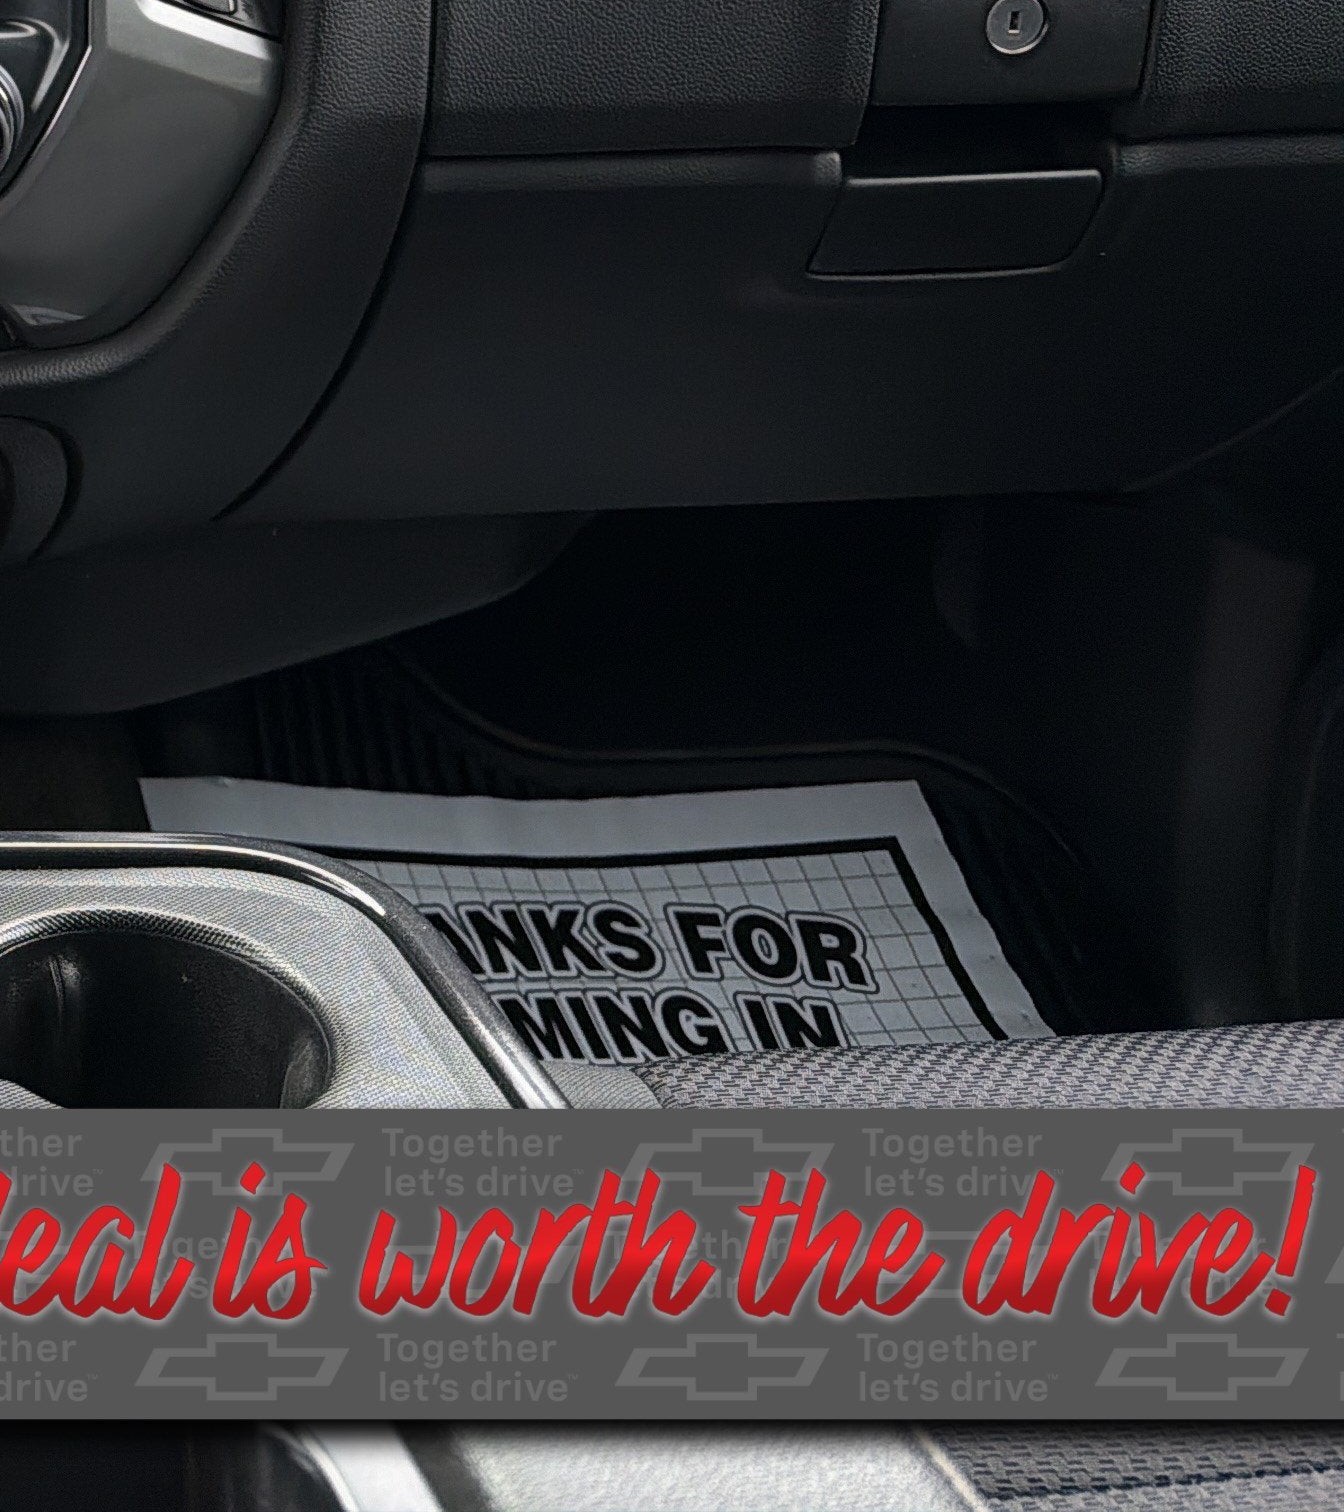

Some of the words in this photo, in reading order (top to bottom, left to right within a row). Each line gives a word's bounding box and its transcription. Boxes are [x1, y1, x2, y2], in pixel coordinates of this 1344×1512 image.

[670, 906, 874, 990] FOR
[496, 992, 732, 1063] MING
[740, 995, 850, 1051] IN
